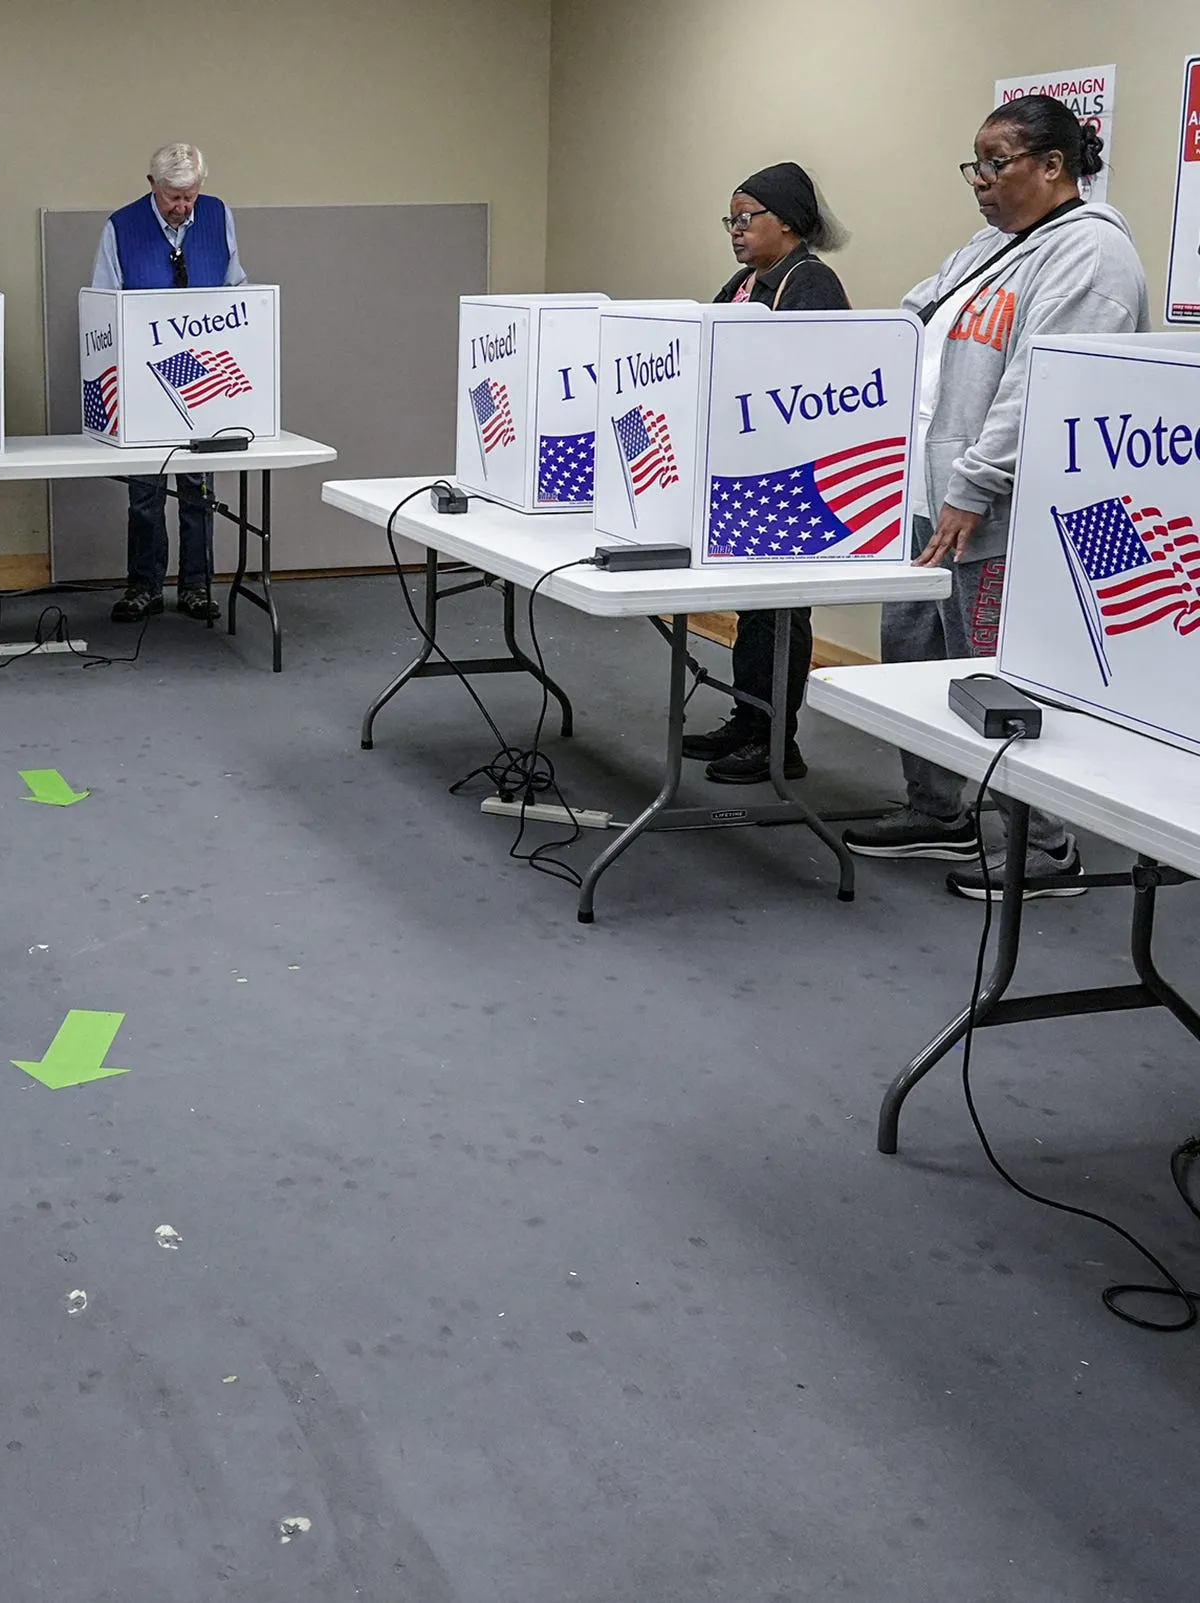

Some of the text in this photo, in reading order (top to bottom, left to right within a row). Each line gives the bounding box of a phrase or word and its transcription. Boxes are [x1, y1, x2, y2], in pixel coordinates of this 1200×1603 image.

[1003, 78, 1105, 103] NO CAMPAIGN
[85, 323, 113, 357] I Voted
[148, 302, 249, 347] I Voted!
[471, 322, 517, 370] I Voted!
[558, 366, 576, 402] I
[615, 357, 624, 395] I
[628, 338, 681, 389] Voted!
[735, 368, 888, 434] I Voted
[1064, 414, 1200, 473] I Vote
